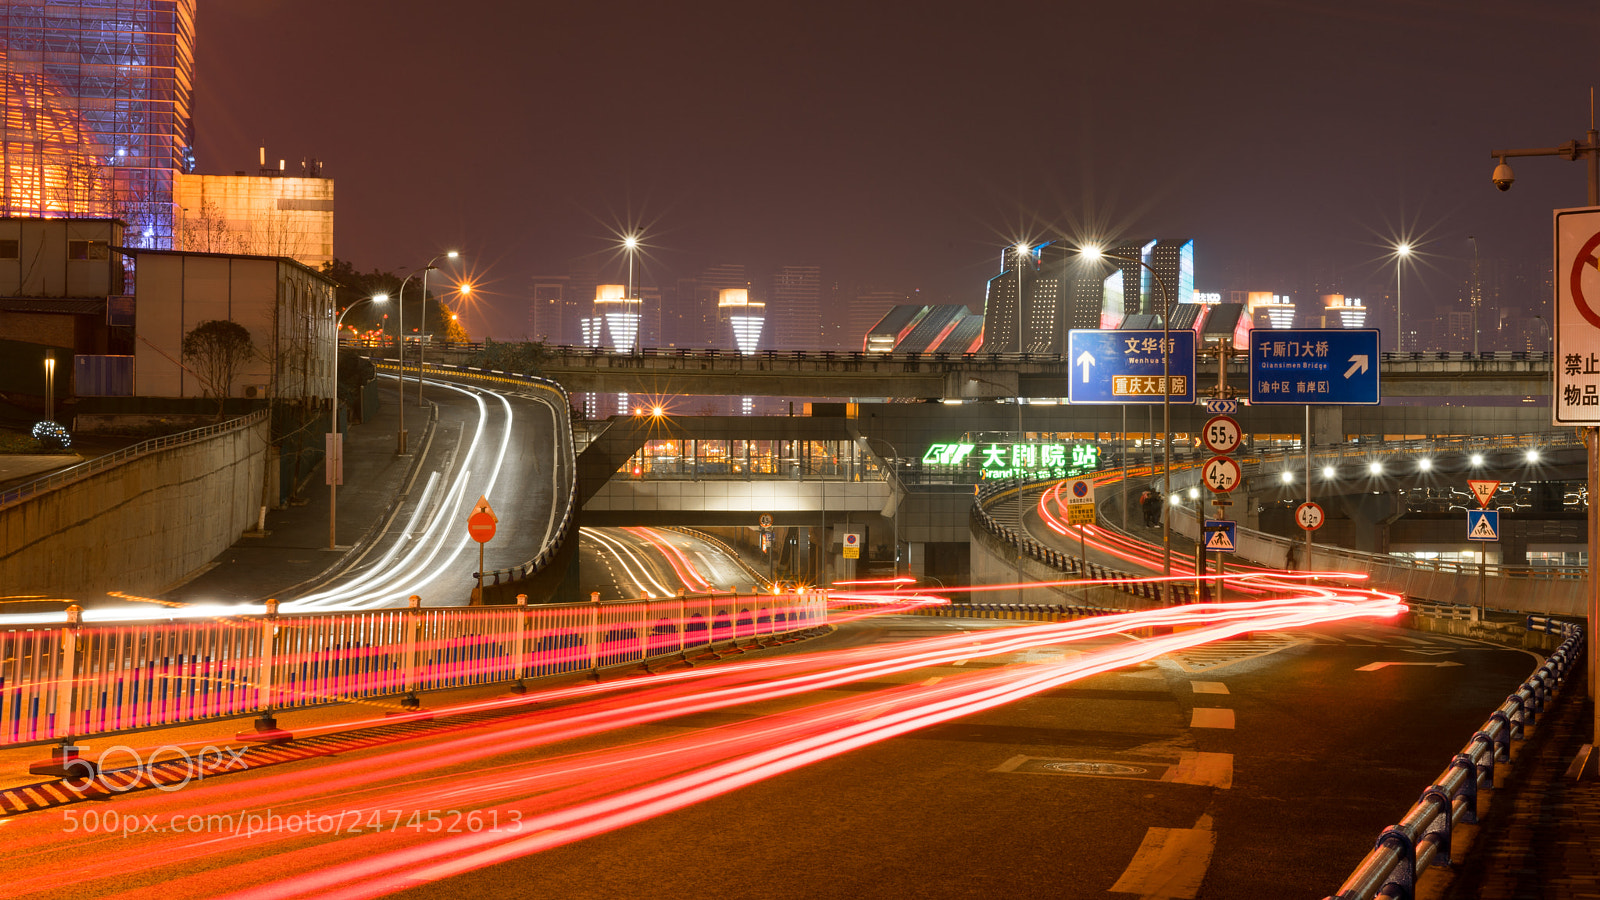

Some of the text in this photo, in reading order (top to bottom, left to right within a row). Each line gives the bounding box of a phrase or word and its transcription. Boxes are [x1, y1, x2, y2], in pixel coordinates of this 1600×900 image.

[1124, 337, 1175, 354] 文华街
[1259, 341, 1329, 358] 千厮门大桥
[1302, 362, 1327, 371] Bridge
[1565, 353, 1600, 375] 禁止
[1564, 384, 1599, 406] 物品
[982, 443, 1097, 468] 大剧院站
[1478, 485, 1489, 496] 让
